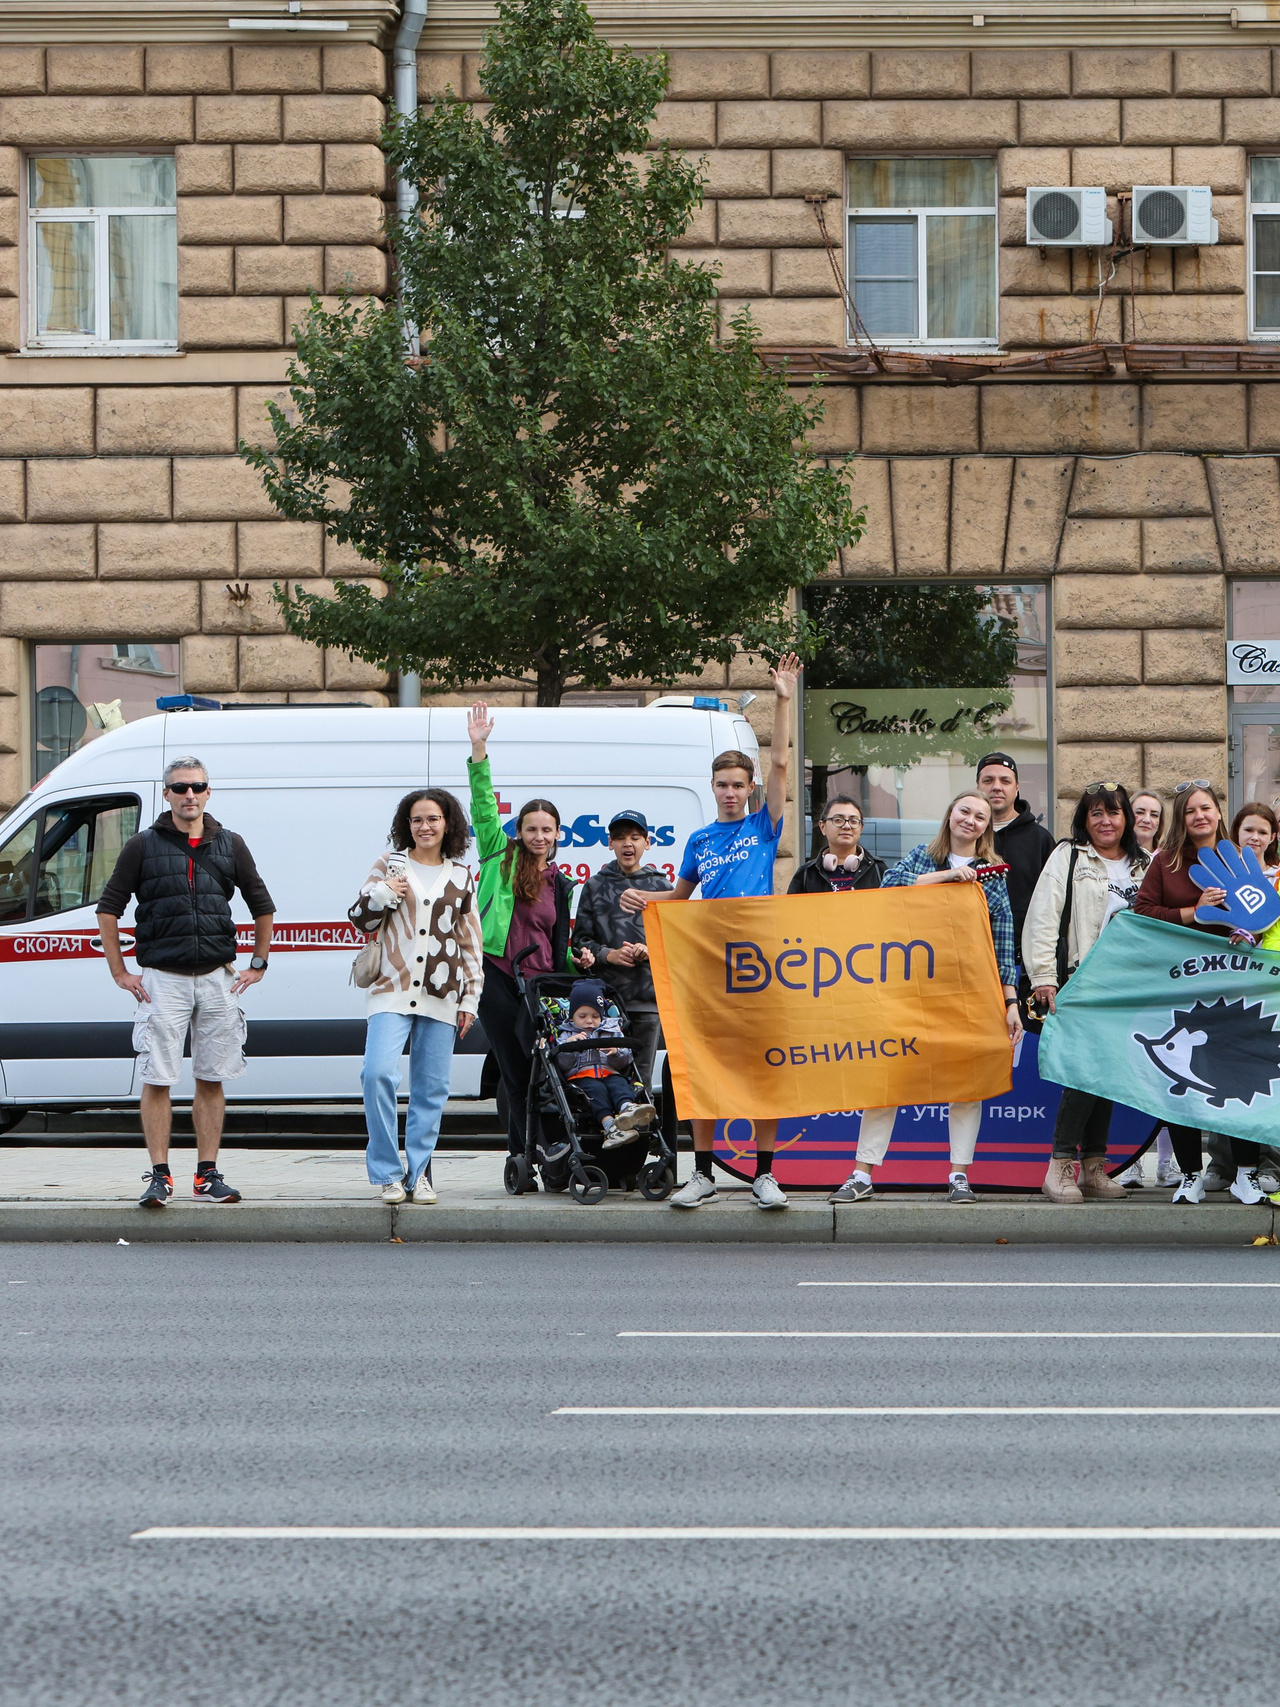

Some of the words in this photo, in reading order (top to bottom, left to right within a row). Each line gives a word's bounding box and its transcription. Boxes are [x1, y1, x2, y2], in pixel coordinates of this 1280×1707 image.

[13, 938, 83, 953] СКОРАЯ
[234, 928, 366, 946] МЕИЦИНСКАЯ
[764, 1036, 920, 1067] ОБНИНСК
[912, 1105, 950, 1121] утр
[989, 1105, 1046, 1121] парк
